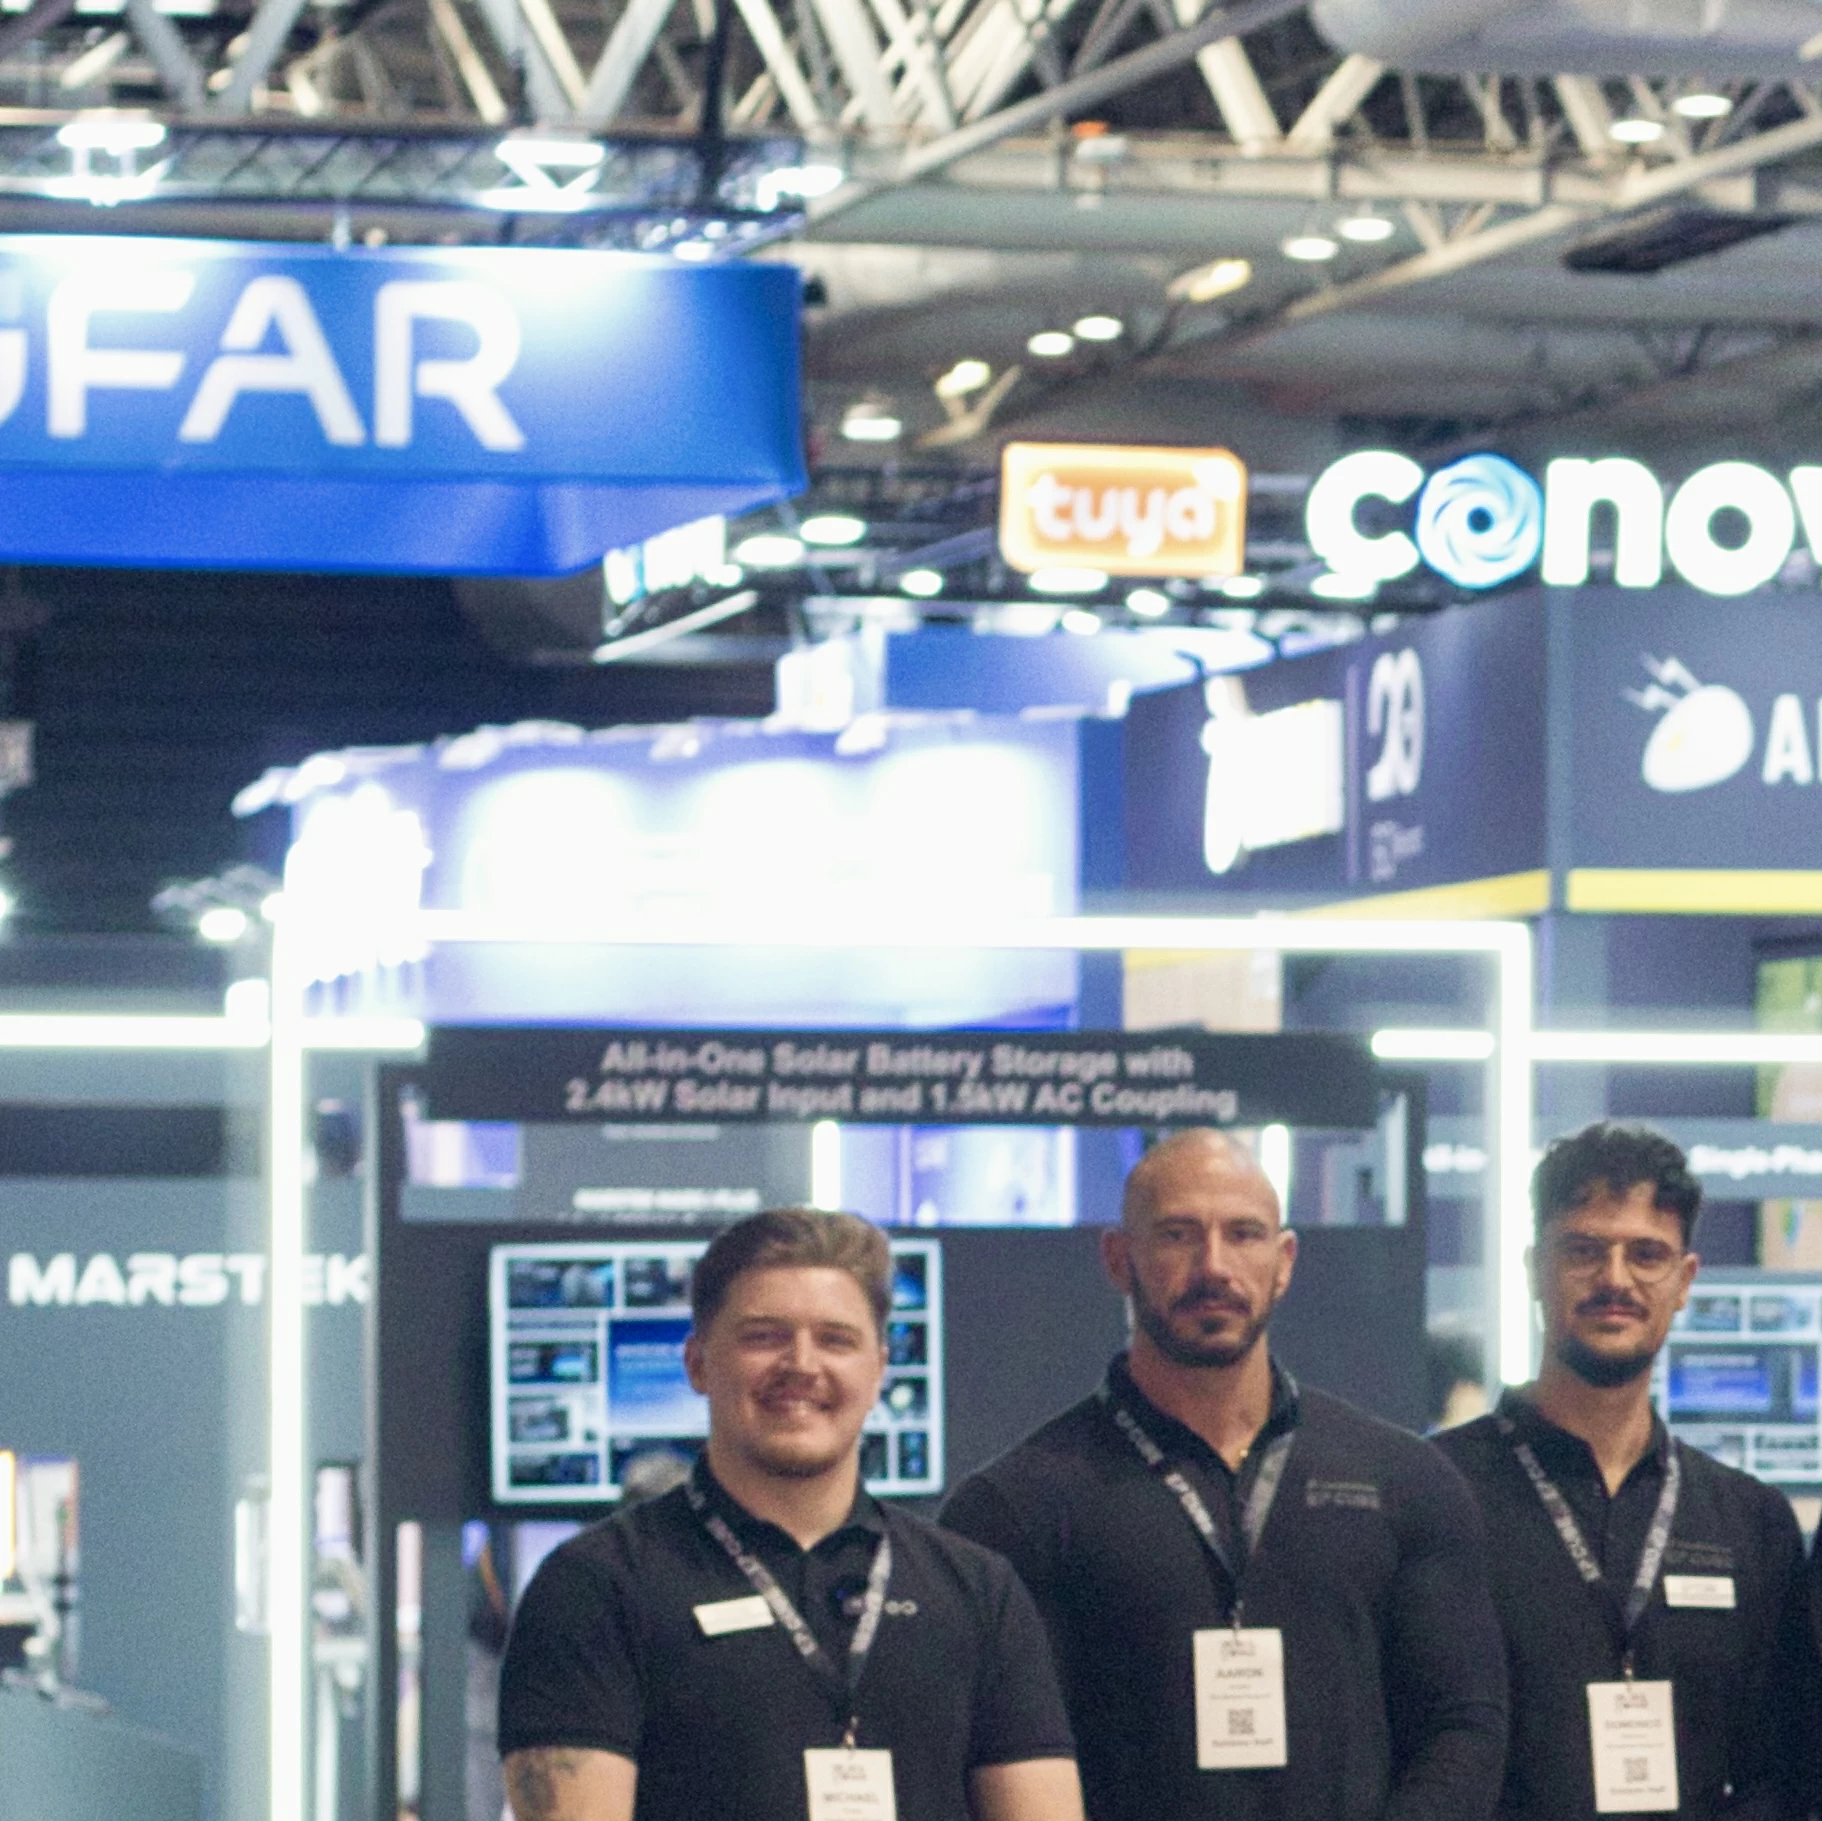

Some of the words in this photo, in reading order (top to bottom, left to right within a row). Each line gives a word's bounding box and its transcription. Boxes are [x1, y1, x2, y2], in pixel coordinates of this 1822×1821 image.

[1027, 472, 1217, 556] tuya
[866, 1042, 985, 1080] Battery
[991, 1044, 1119, 1083] Storage
[1124, 1045, 1195, 1078] with
[859, 1081, 923, 1112] and
[1032, 1082, 1085, 1115] AC
[1090, 1082, 1238, 1122] Coupling
